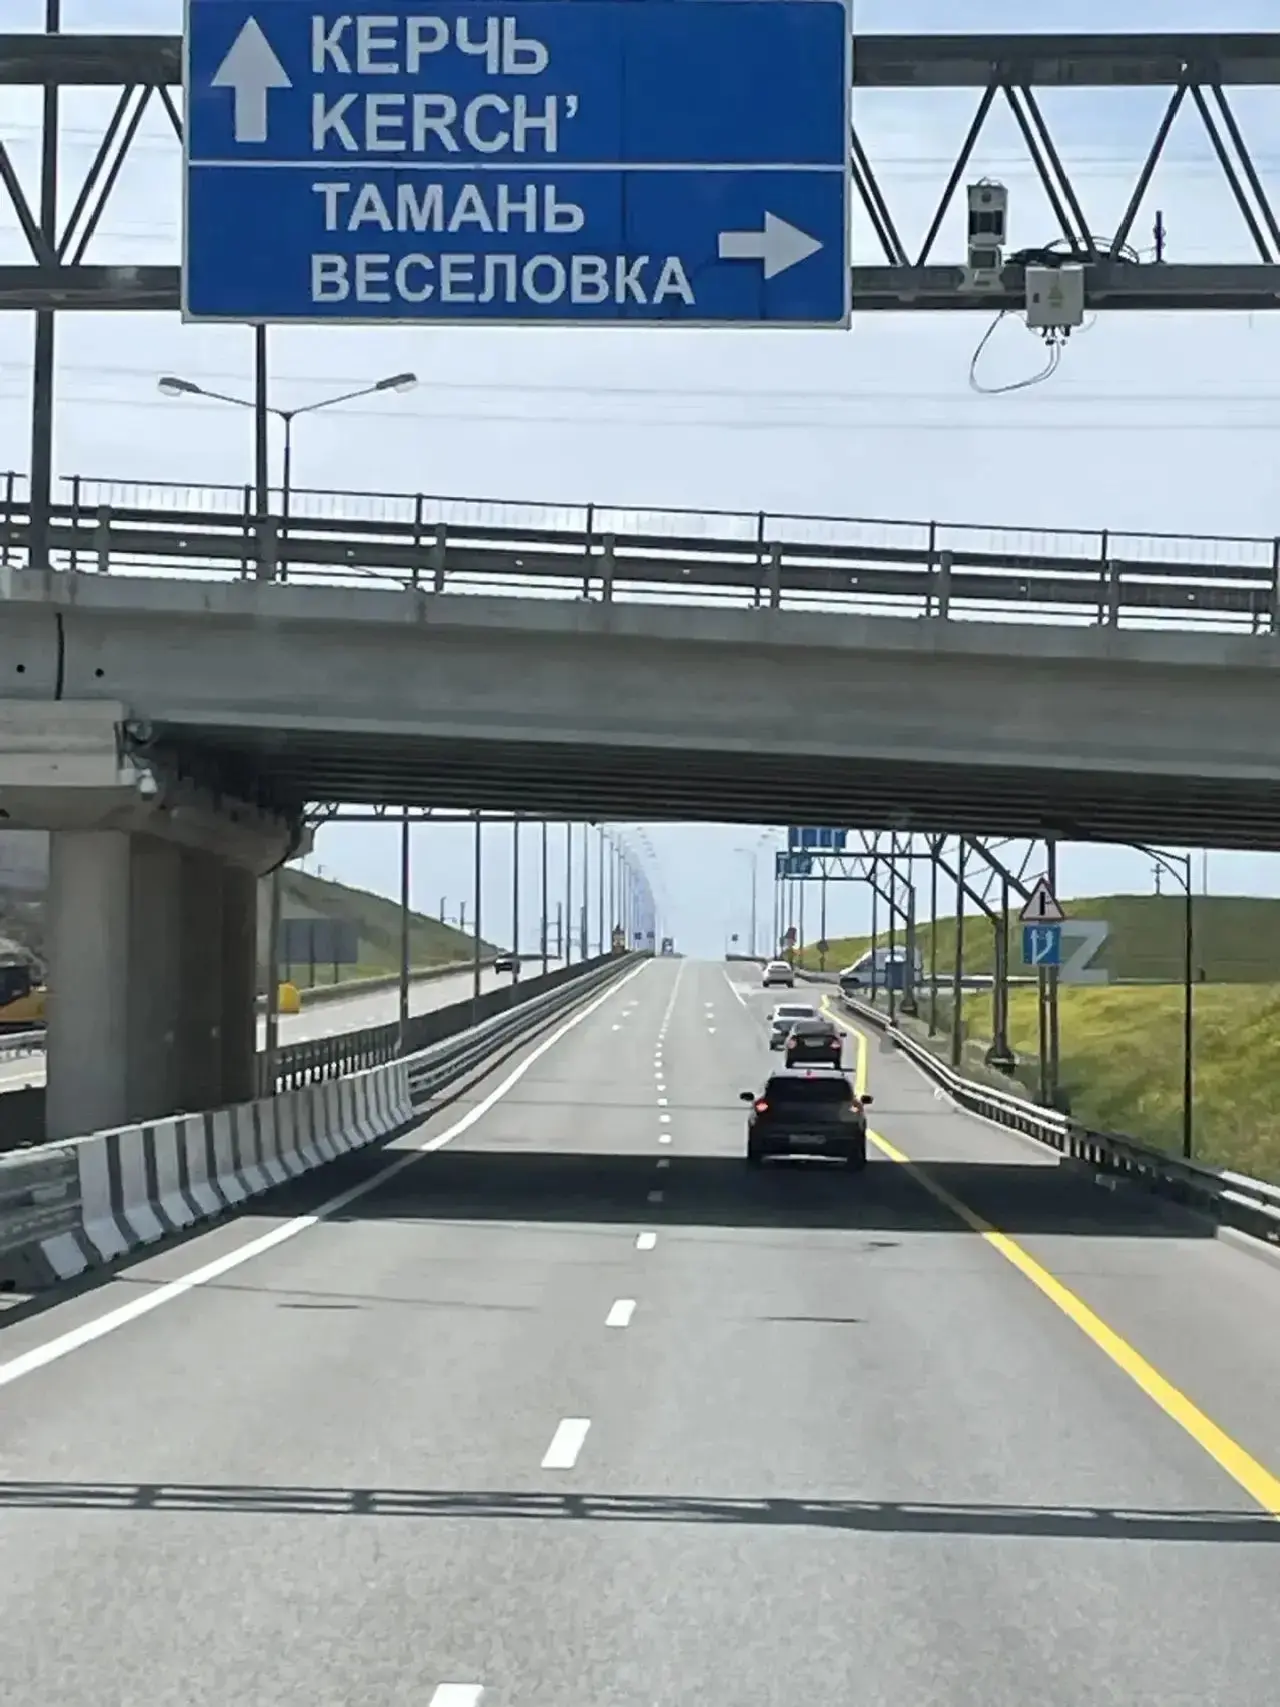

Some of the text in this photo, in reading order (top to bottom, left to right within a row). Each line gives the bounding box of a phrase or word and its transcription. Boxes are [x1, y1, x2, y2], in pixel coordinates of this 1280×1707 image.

[312, 15, 549, 75] КЕРЧЬ
[312, 182, 585, 233] ТАМАНЬ
[312, 253, 695, 304] ВЕСЕЛОВКА
